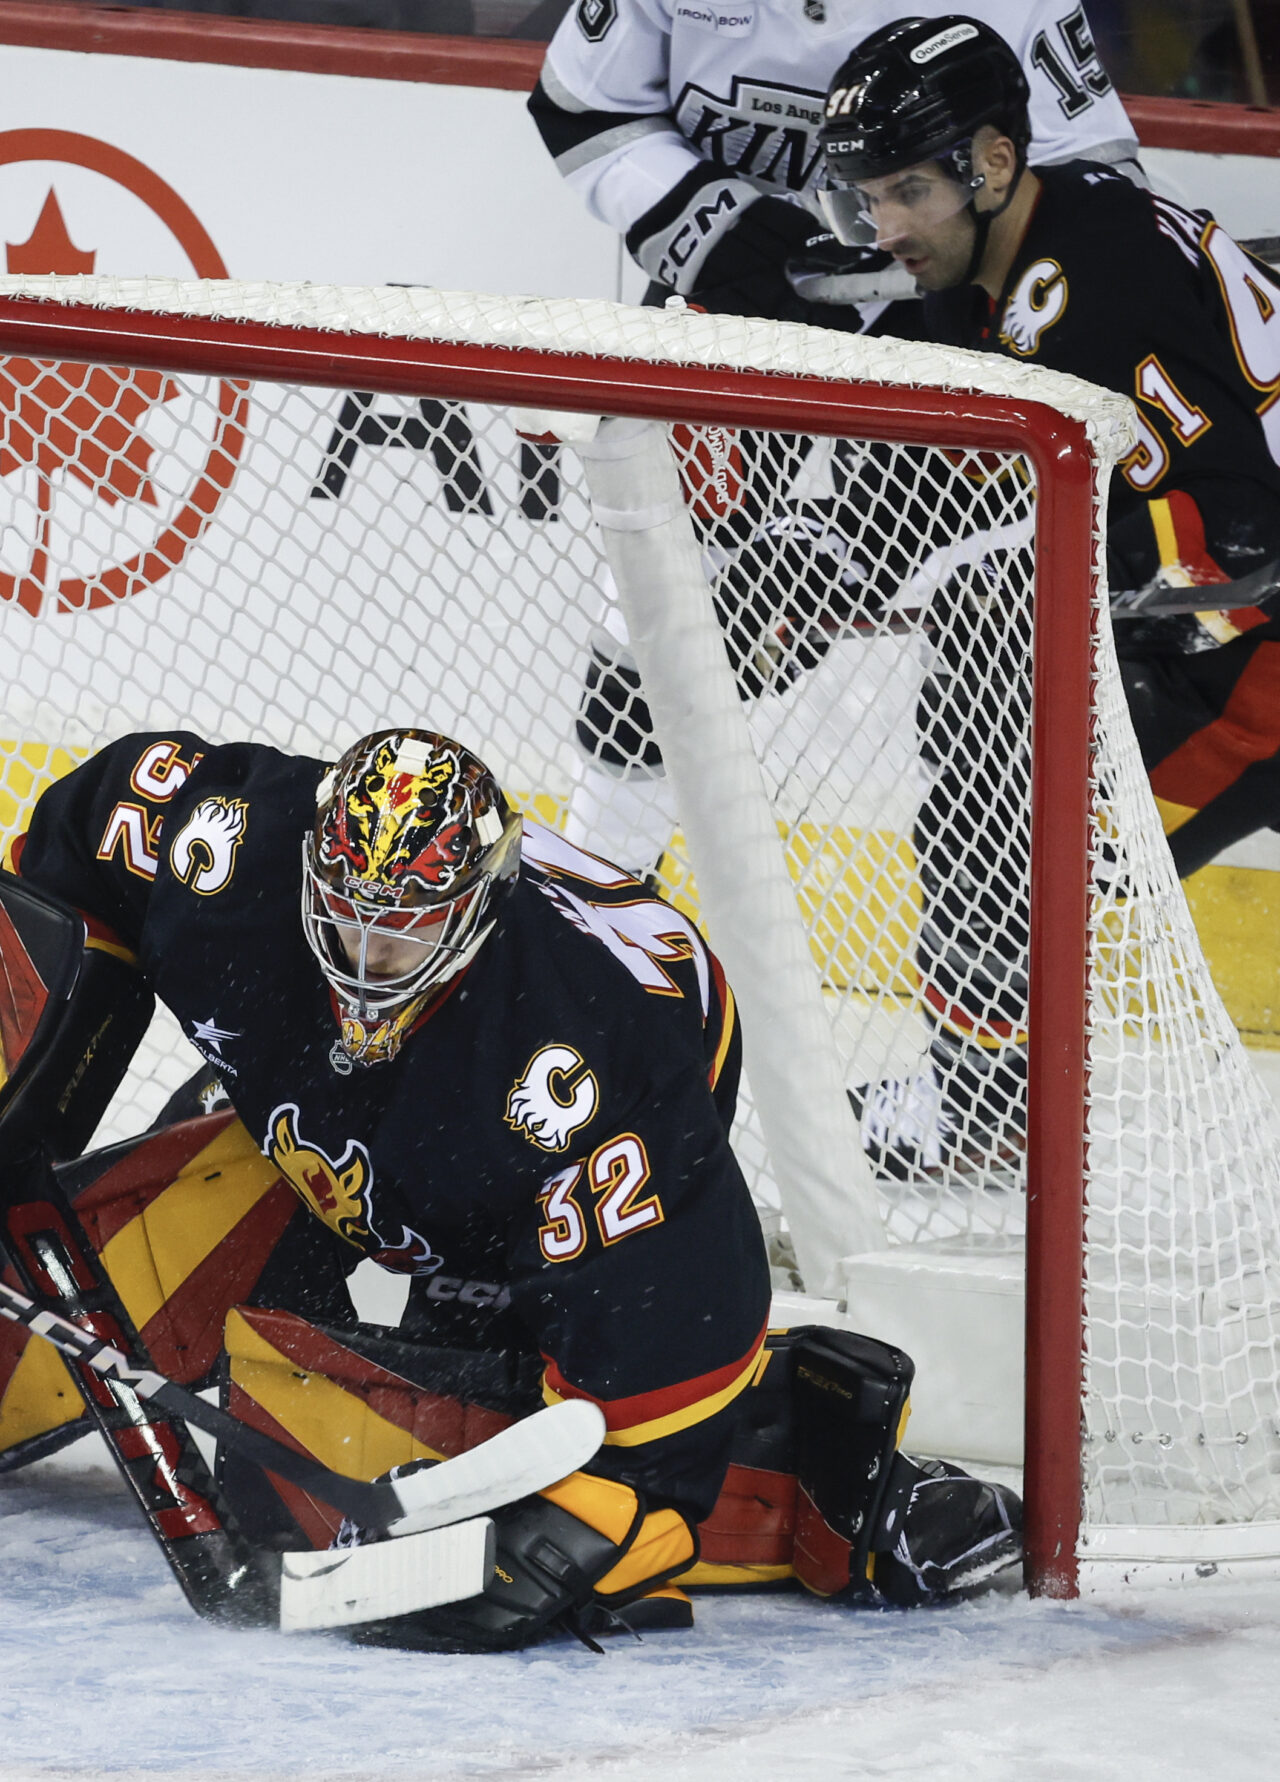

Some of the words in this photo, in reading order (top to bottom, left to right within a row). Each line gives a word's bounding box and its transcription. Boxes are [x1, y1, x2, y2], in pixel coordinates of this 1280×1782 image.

[677, 7, 713, 23] IRON
[718, 14, 753, 27] BOW
[914, 26, 975, 60] GameSense
[1031, 4, 1112, 121] 15
[751, 97, 782, 115] Los
[787, 103, 822, 125] Ang
[825, 84, 862, 118] 91
[688, 104, 826, 191] KIN
[826, 139, 865, 153] CCM
[658, 188, 738, 289] CCM
[1117, 353, 1213, 492] 91
[96, 740, 205, 882] 32
[343, 874, 404, 899] CCM
[534, 1131, 665, 1263] 32
